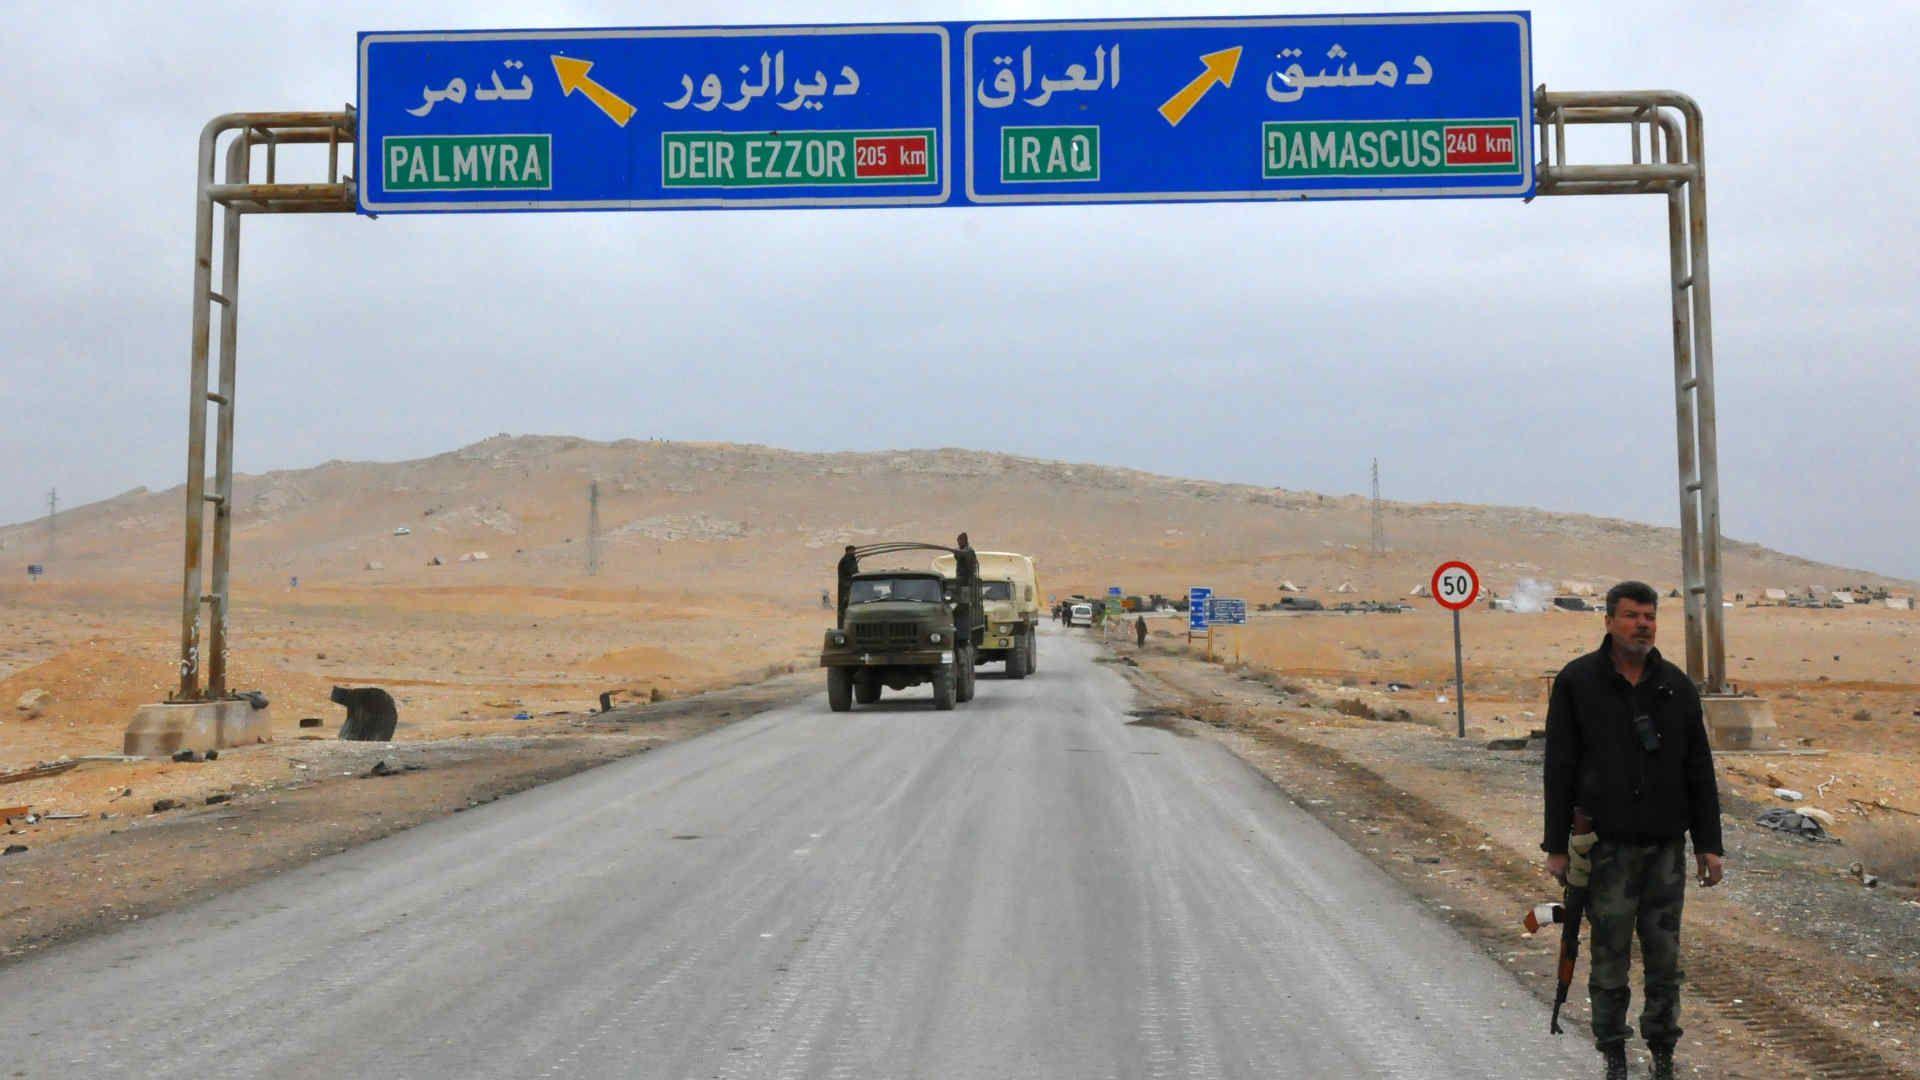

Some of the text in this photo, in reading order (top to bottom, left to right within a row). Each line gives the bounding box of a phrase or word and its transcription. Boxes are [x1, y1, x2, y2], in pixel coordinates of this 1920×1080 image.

[405, 59, 534, 117] تدمر
[977, 43, 1120, 108] العراق
[1266, 43, 1433, 102] دمشق
[390, 144, 543, 182] PALMYRA
[668, 140, 925, 179] DEIR EZZOR 205 km
[1008, 134, 1092, 173] IRAQ
[1268, 130, 1512, 169] DAMASCUS 240 km
[1443, 575, 1468, 596] 50
